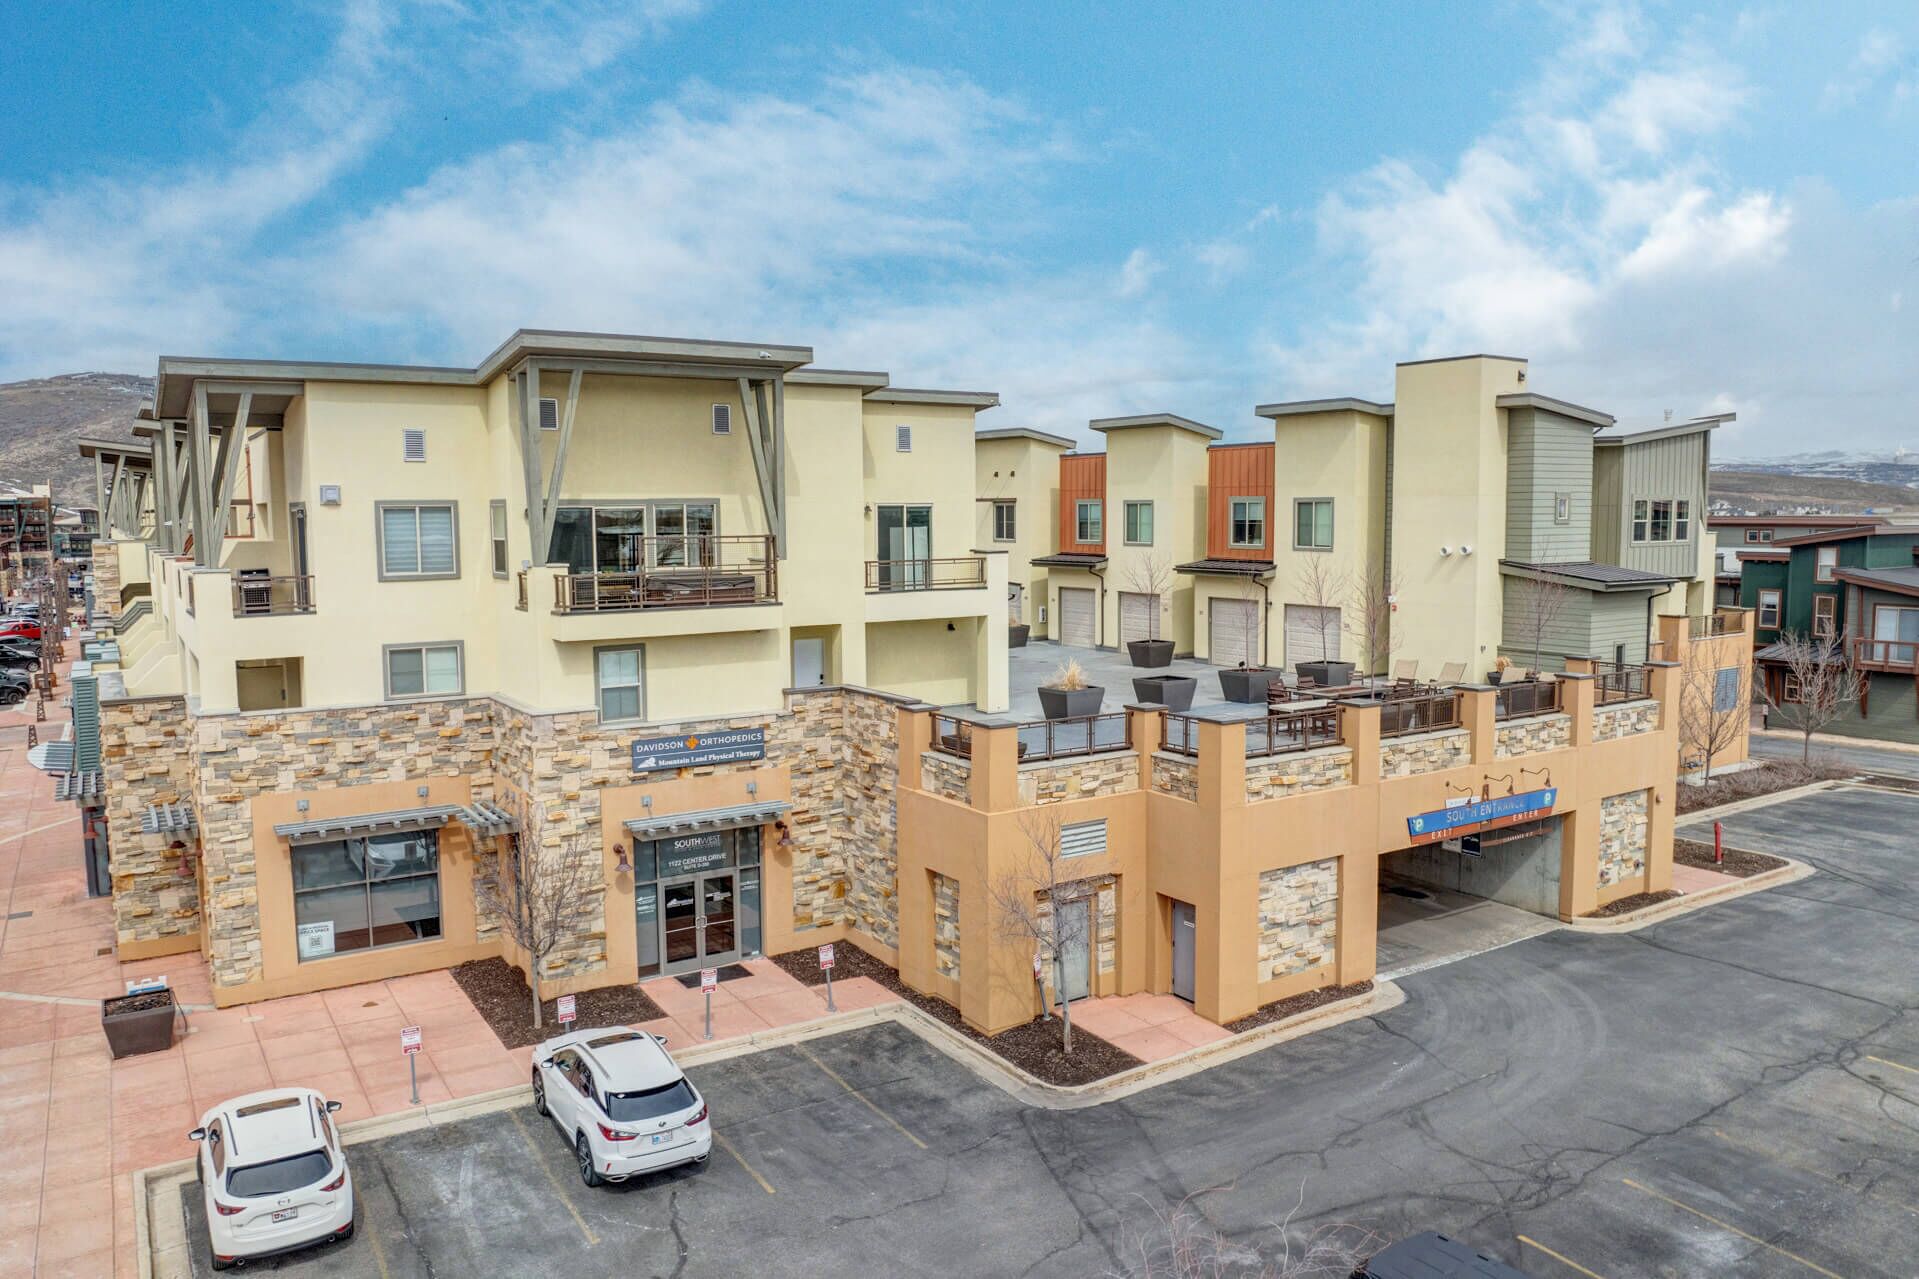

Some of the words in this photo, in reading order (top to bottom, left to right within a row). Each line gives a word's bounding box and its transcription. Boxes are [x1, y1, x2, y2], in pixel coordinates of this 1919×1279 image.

[636, 741, 684, 753] DAVIDSON
[700, 733, 762, 746] ORTHOPEDICS
[658, 757, 690, 766] Mountain
[691, 755, 707, 763] Land
[708, 751, 735, 761] Physical
[736, 750, 761, 759] Therapy
[1512, 810, 1539, 822] ENTER
[1431, 828, 1453, 840] EXIT
[682, 855, 707, 865] CENTER
[708, 852, 727, 861] DRIVE
